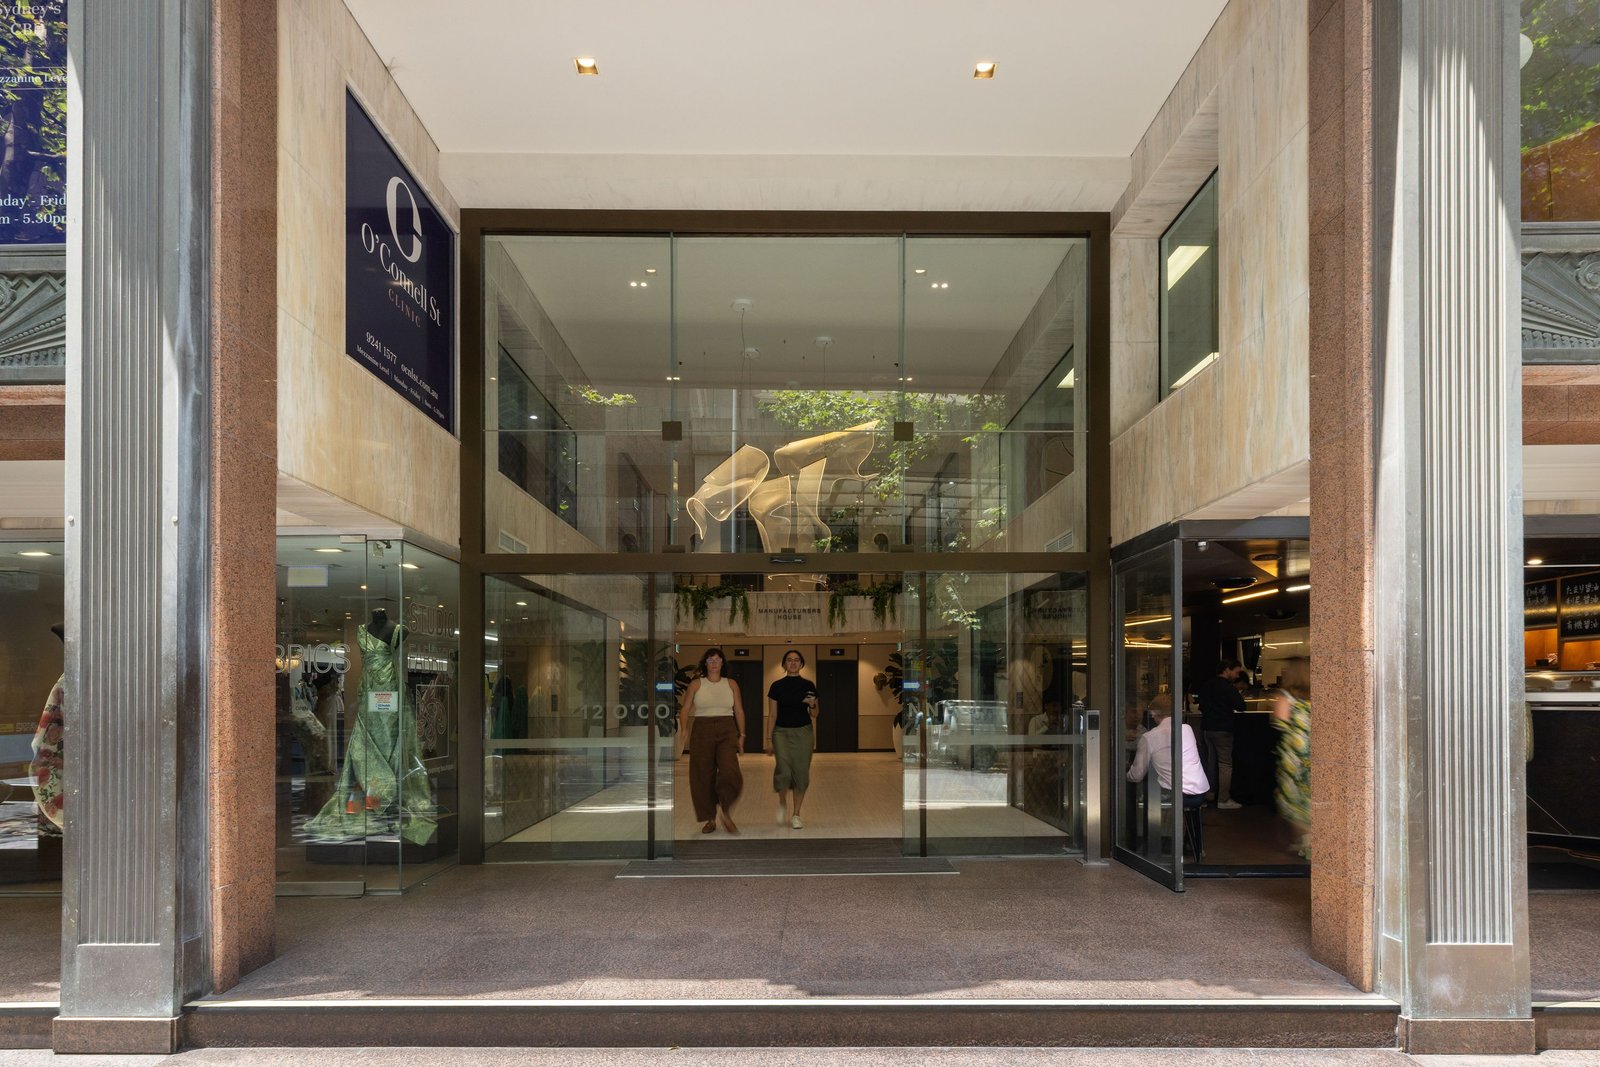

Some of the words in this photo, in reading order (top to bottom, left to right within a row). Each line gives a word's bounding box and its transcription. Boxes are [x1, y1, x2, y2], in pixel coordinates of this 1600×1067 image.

[0, 3, 62, 19] ydney's
[40, 193, 67, 206] Frid
[361, 222, 427, 313] O'Connell
[429, 296, 441, 327] St
[388, 288, 421, 328] CLINIC
[366, 331, 382, 353] 9241
[383, 346, 398, 365] 1577
[408, 602, 457, 639] STUDIO
[580, 703, 604, 720] 12
[614, 703, 670, 720] O'CO
